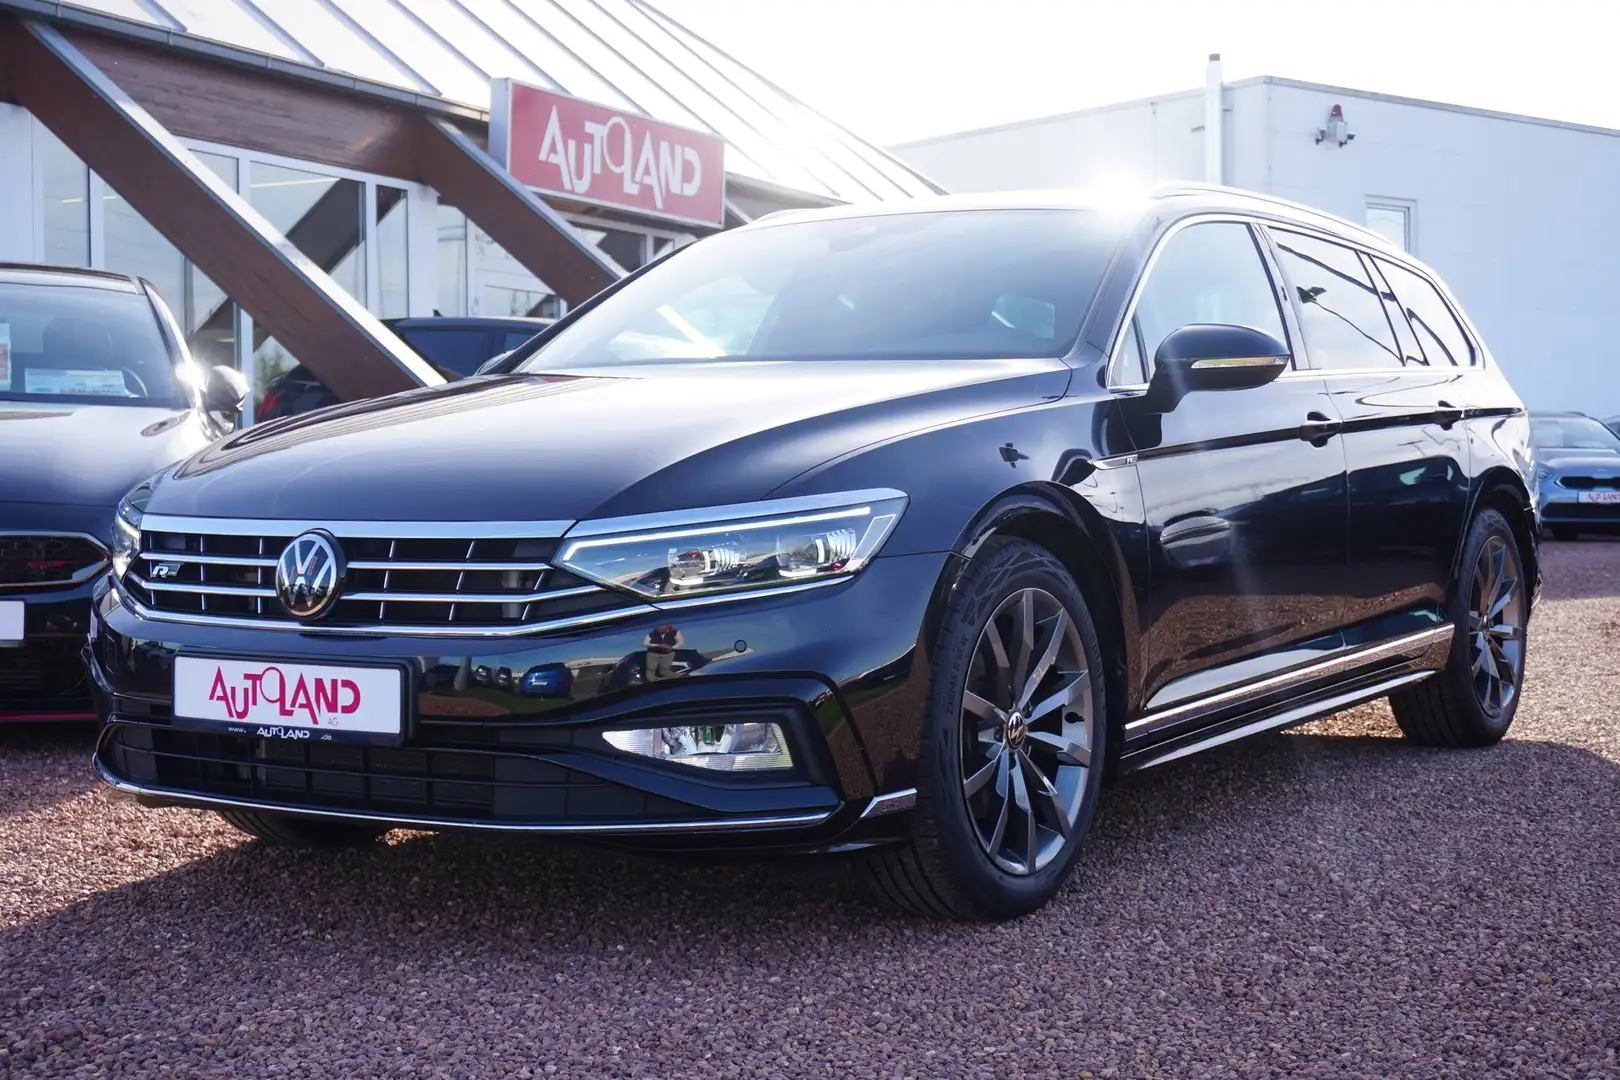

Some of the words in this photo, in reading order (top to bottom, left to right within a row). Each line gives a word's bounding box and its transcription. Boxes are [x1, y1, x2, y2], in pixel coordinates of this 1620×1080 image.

[538, 104, 702, 210] AUTOLAND
[208, 665, 361, 725] AUTOLAND
[256, 726, 310, 740] AUTOLAND
